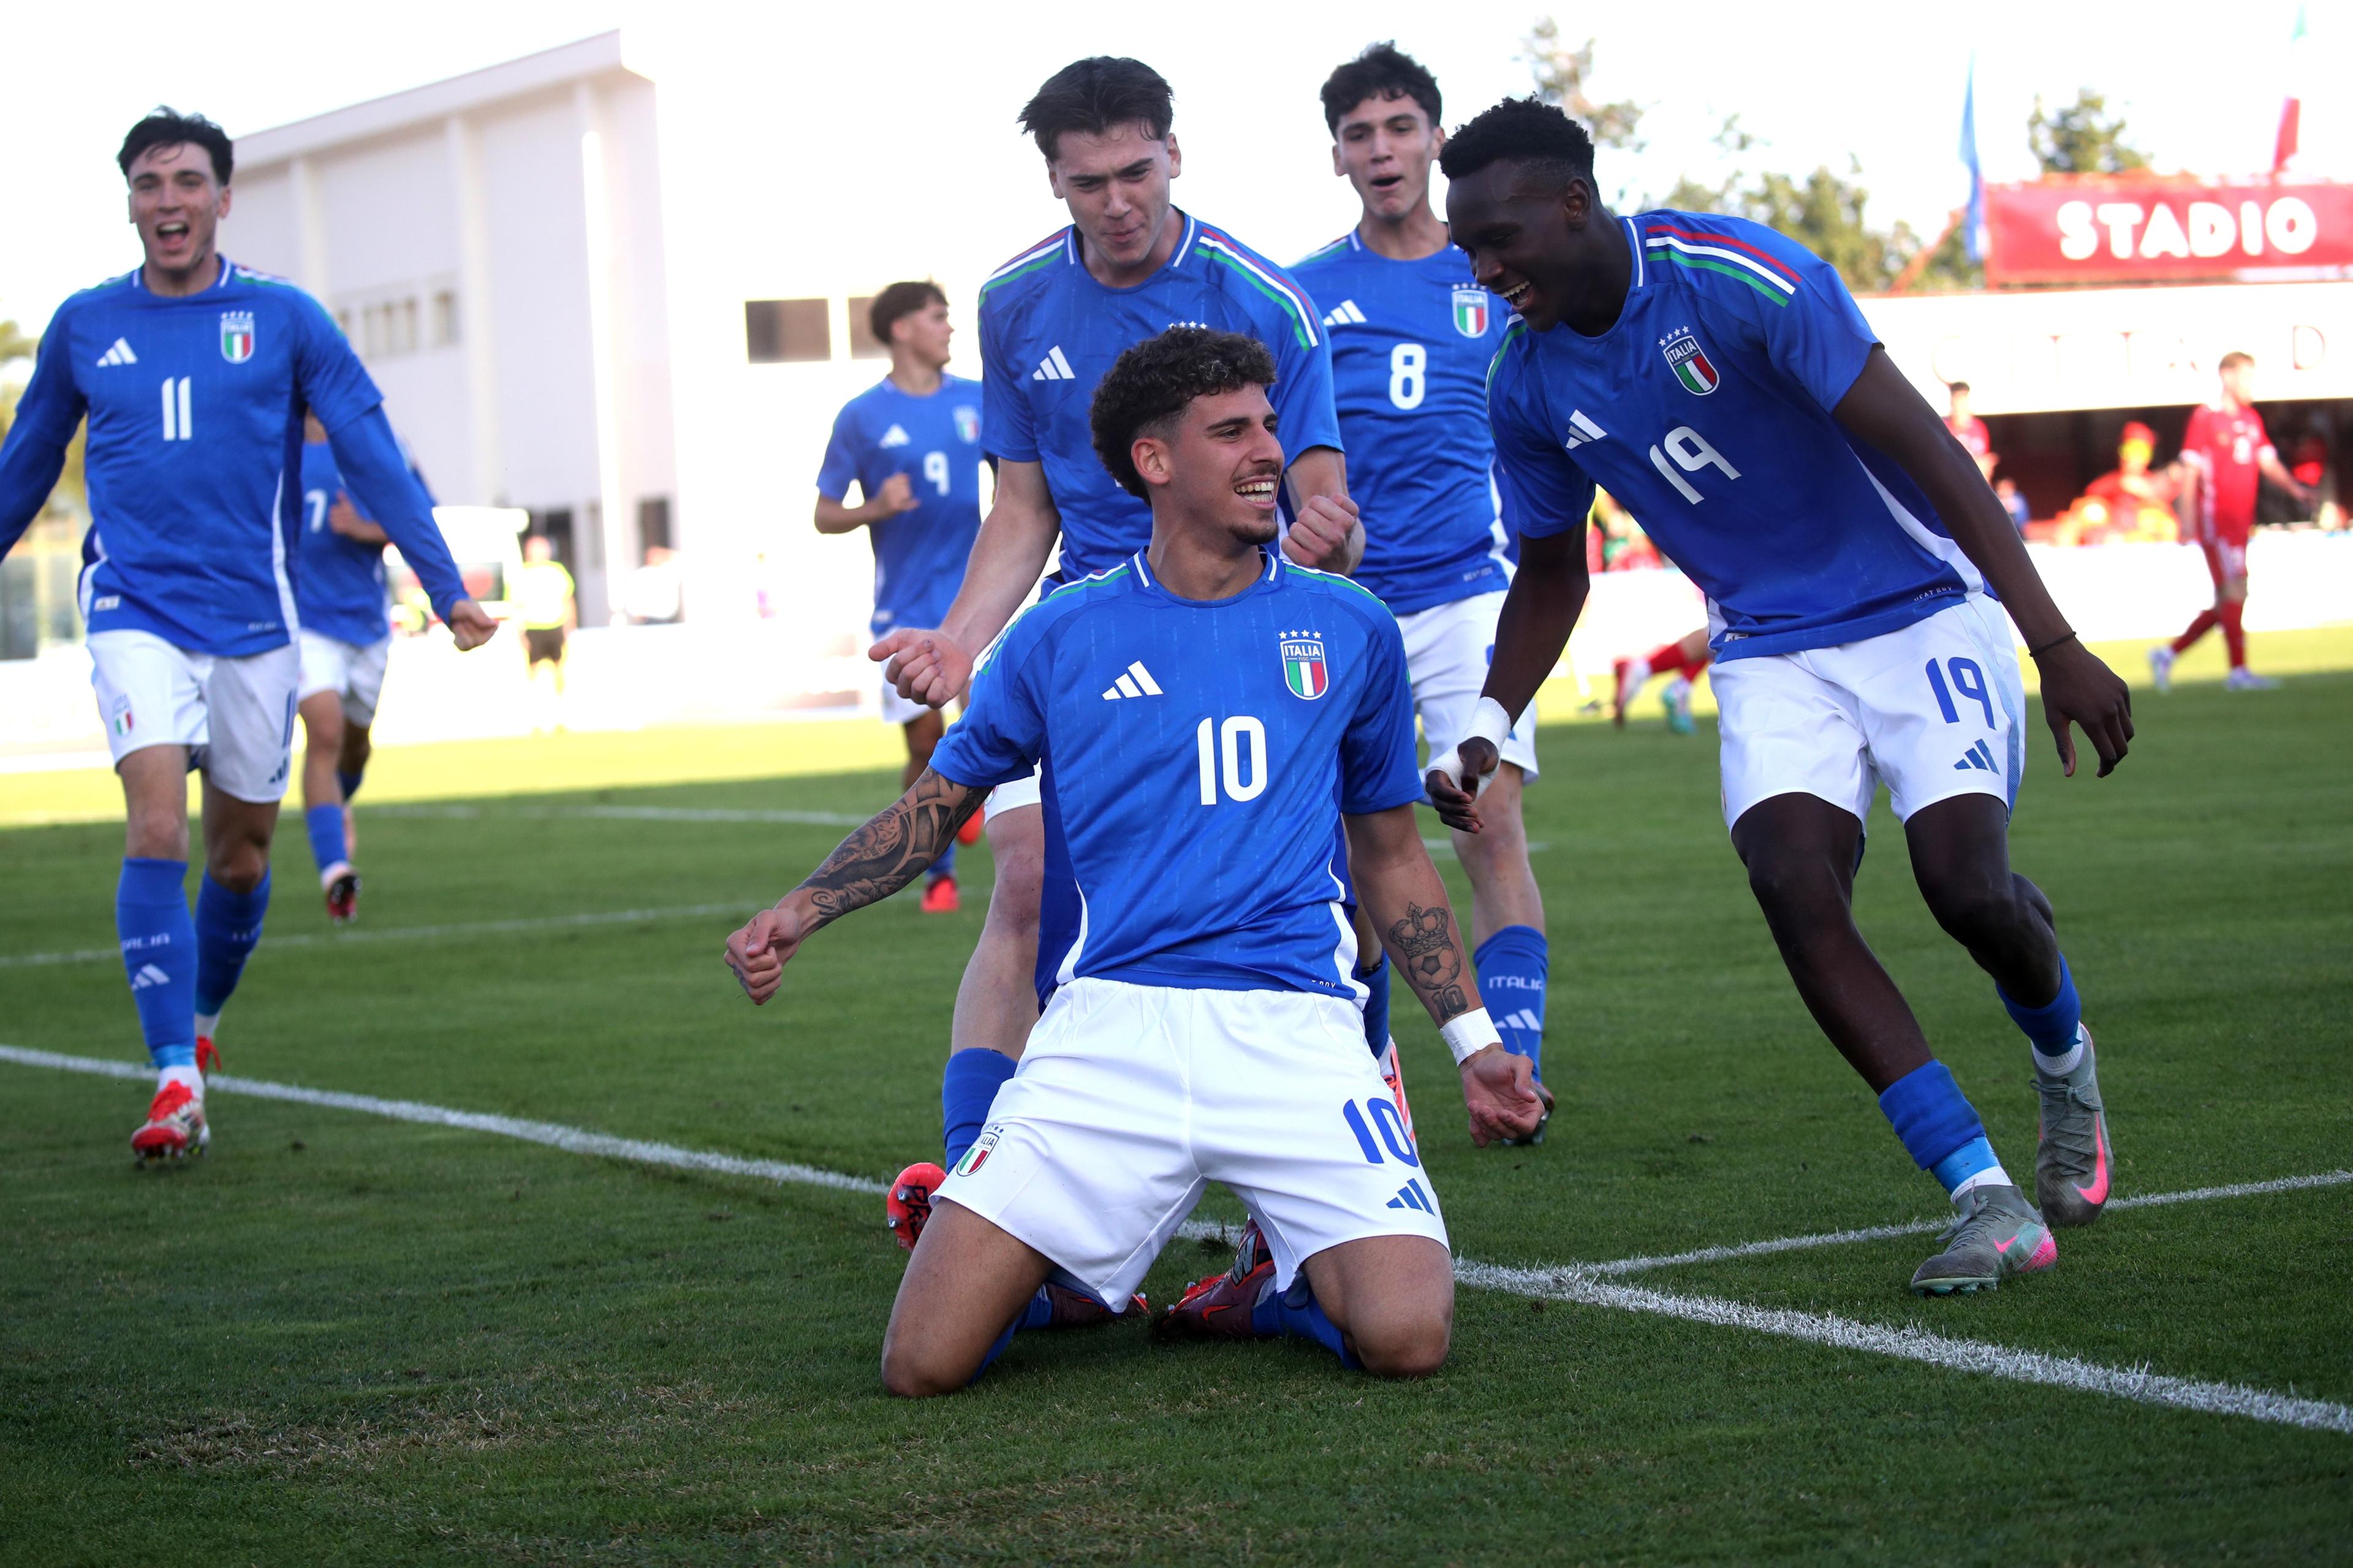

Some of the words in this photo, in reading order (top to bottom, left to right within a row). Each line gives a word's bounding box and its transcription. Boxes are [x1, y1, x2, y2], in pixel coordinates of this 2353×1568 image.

[2056, 196, 2317, 260] STADIO
[1389, 343, 1427, 411] 8
[1667, 341, 1697, 363] ITALIA
[161, 376, 192, 441] 11
[923, 451, 950, 496] 9
[1649, 426, 1742, 506] 19
[305, 488, 328, 533] 7
[1284, 645, 1321, 656] ITALIA
[1925, 656, 1996, 730] 19
[1197, 715, 1268, 806] 10
[1488, 975, 1544, 991] ITALIA
[1343, 1097, 1419, 1168] 10
